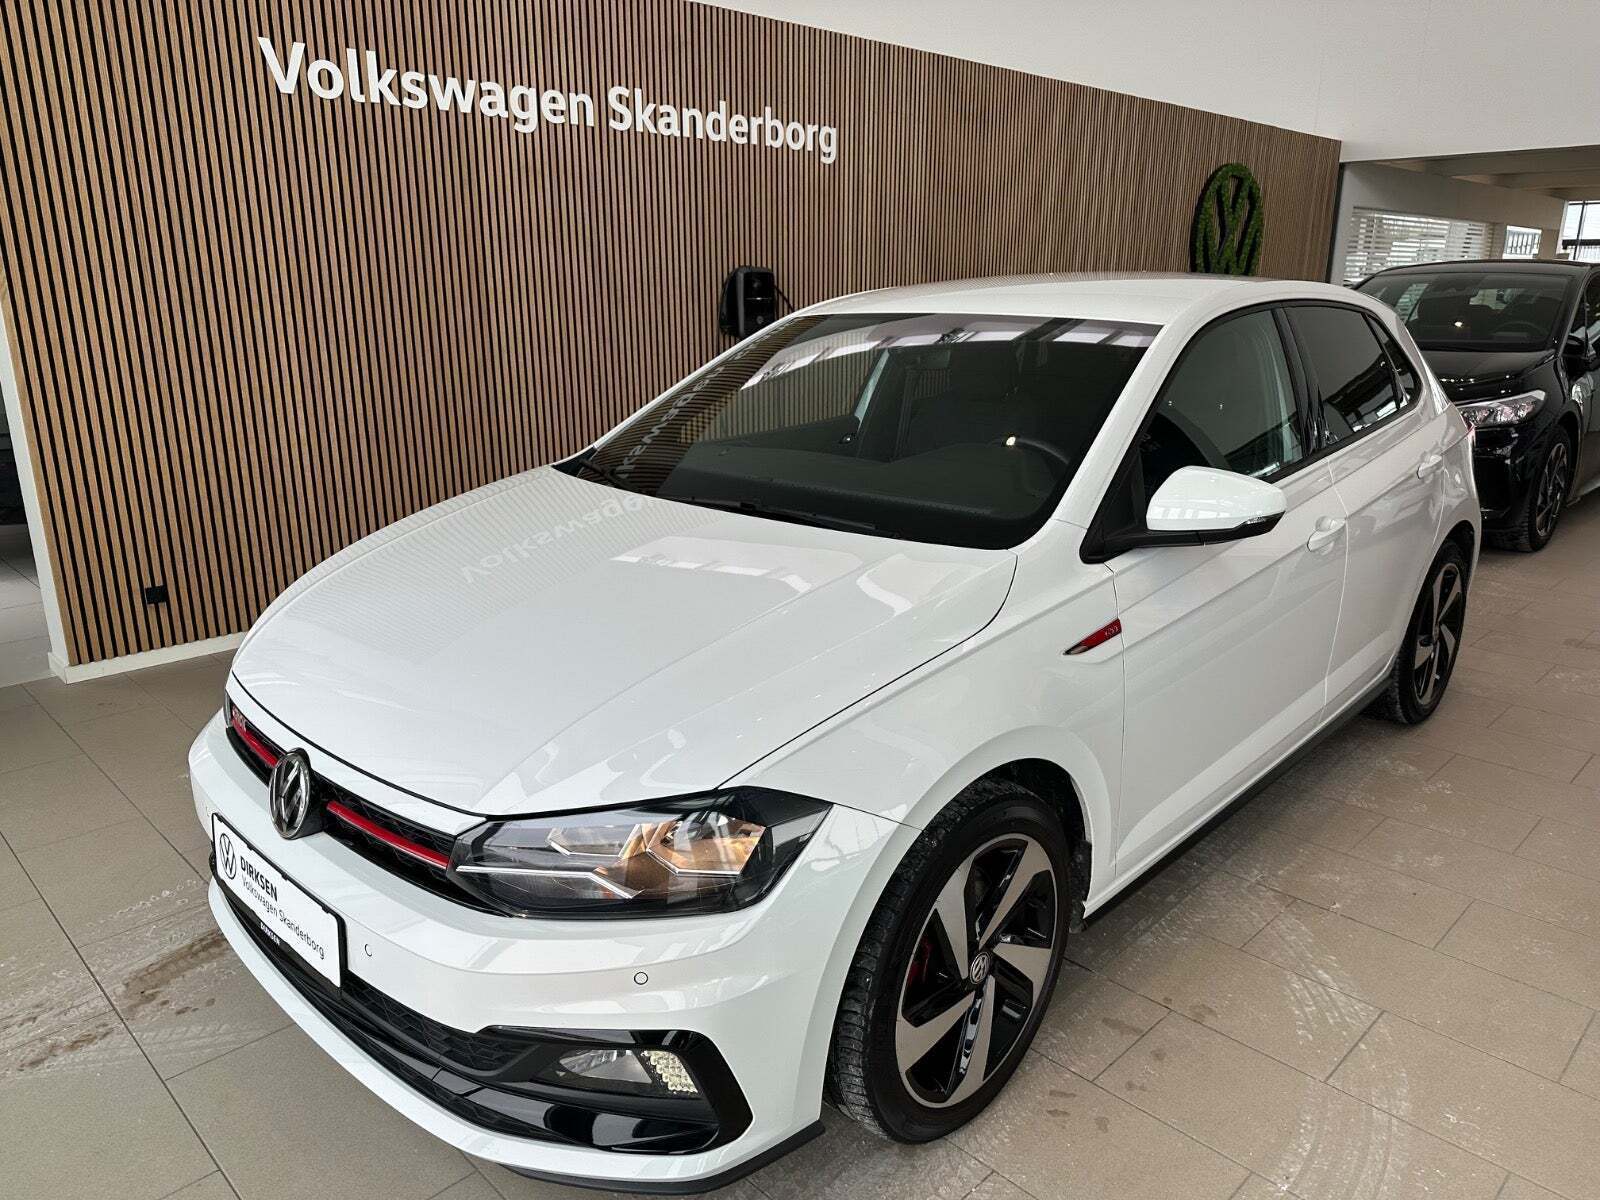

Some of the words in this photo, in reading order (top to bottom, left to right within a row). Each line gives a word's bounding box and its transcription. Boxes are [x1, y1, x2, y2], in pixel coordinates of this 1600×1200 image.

[258, 36, 595, 134] Volkswagen
[608, 86, 838, 165] Skanderborg
[240, 855, 278, 903] DIRKSEN
[241, 874, 279, 917] Volkswagen
[278, 908, 325, 961] Skanderborg
